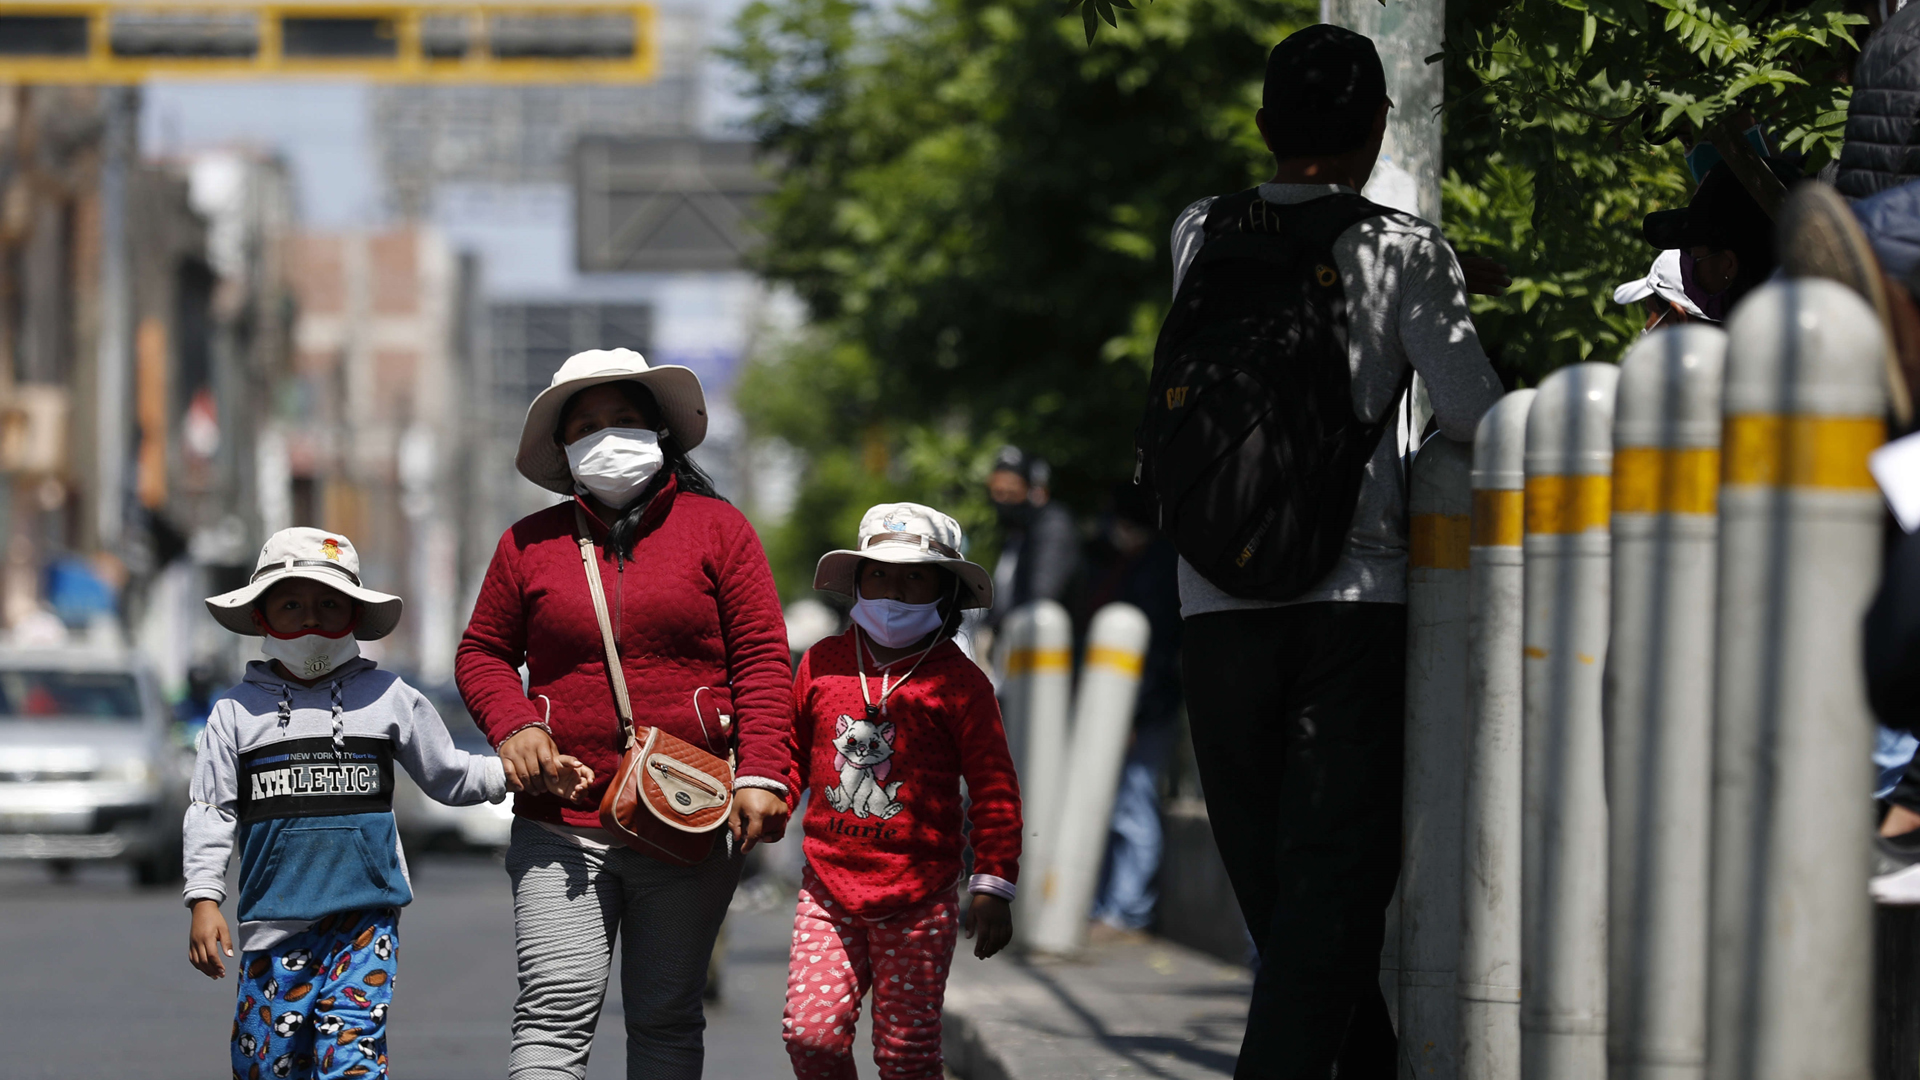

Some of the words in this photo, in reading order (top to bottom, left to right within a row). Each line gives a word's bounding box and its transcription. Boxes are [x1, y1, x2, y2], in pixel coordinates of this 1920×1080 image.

[1166, 385, 1190, 411] CAT
[290, 752, 311, 760] NEW
[312, 752, 334, 760] YORK
[251, 766, 370, 800] ATHLETIC
[825, 816, 898, 839] Marie
